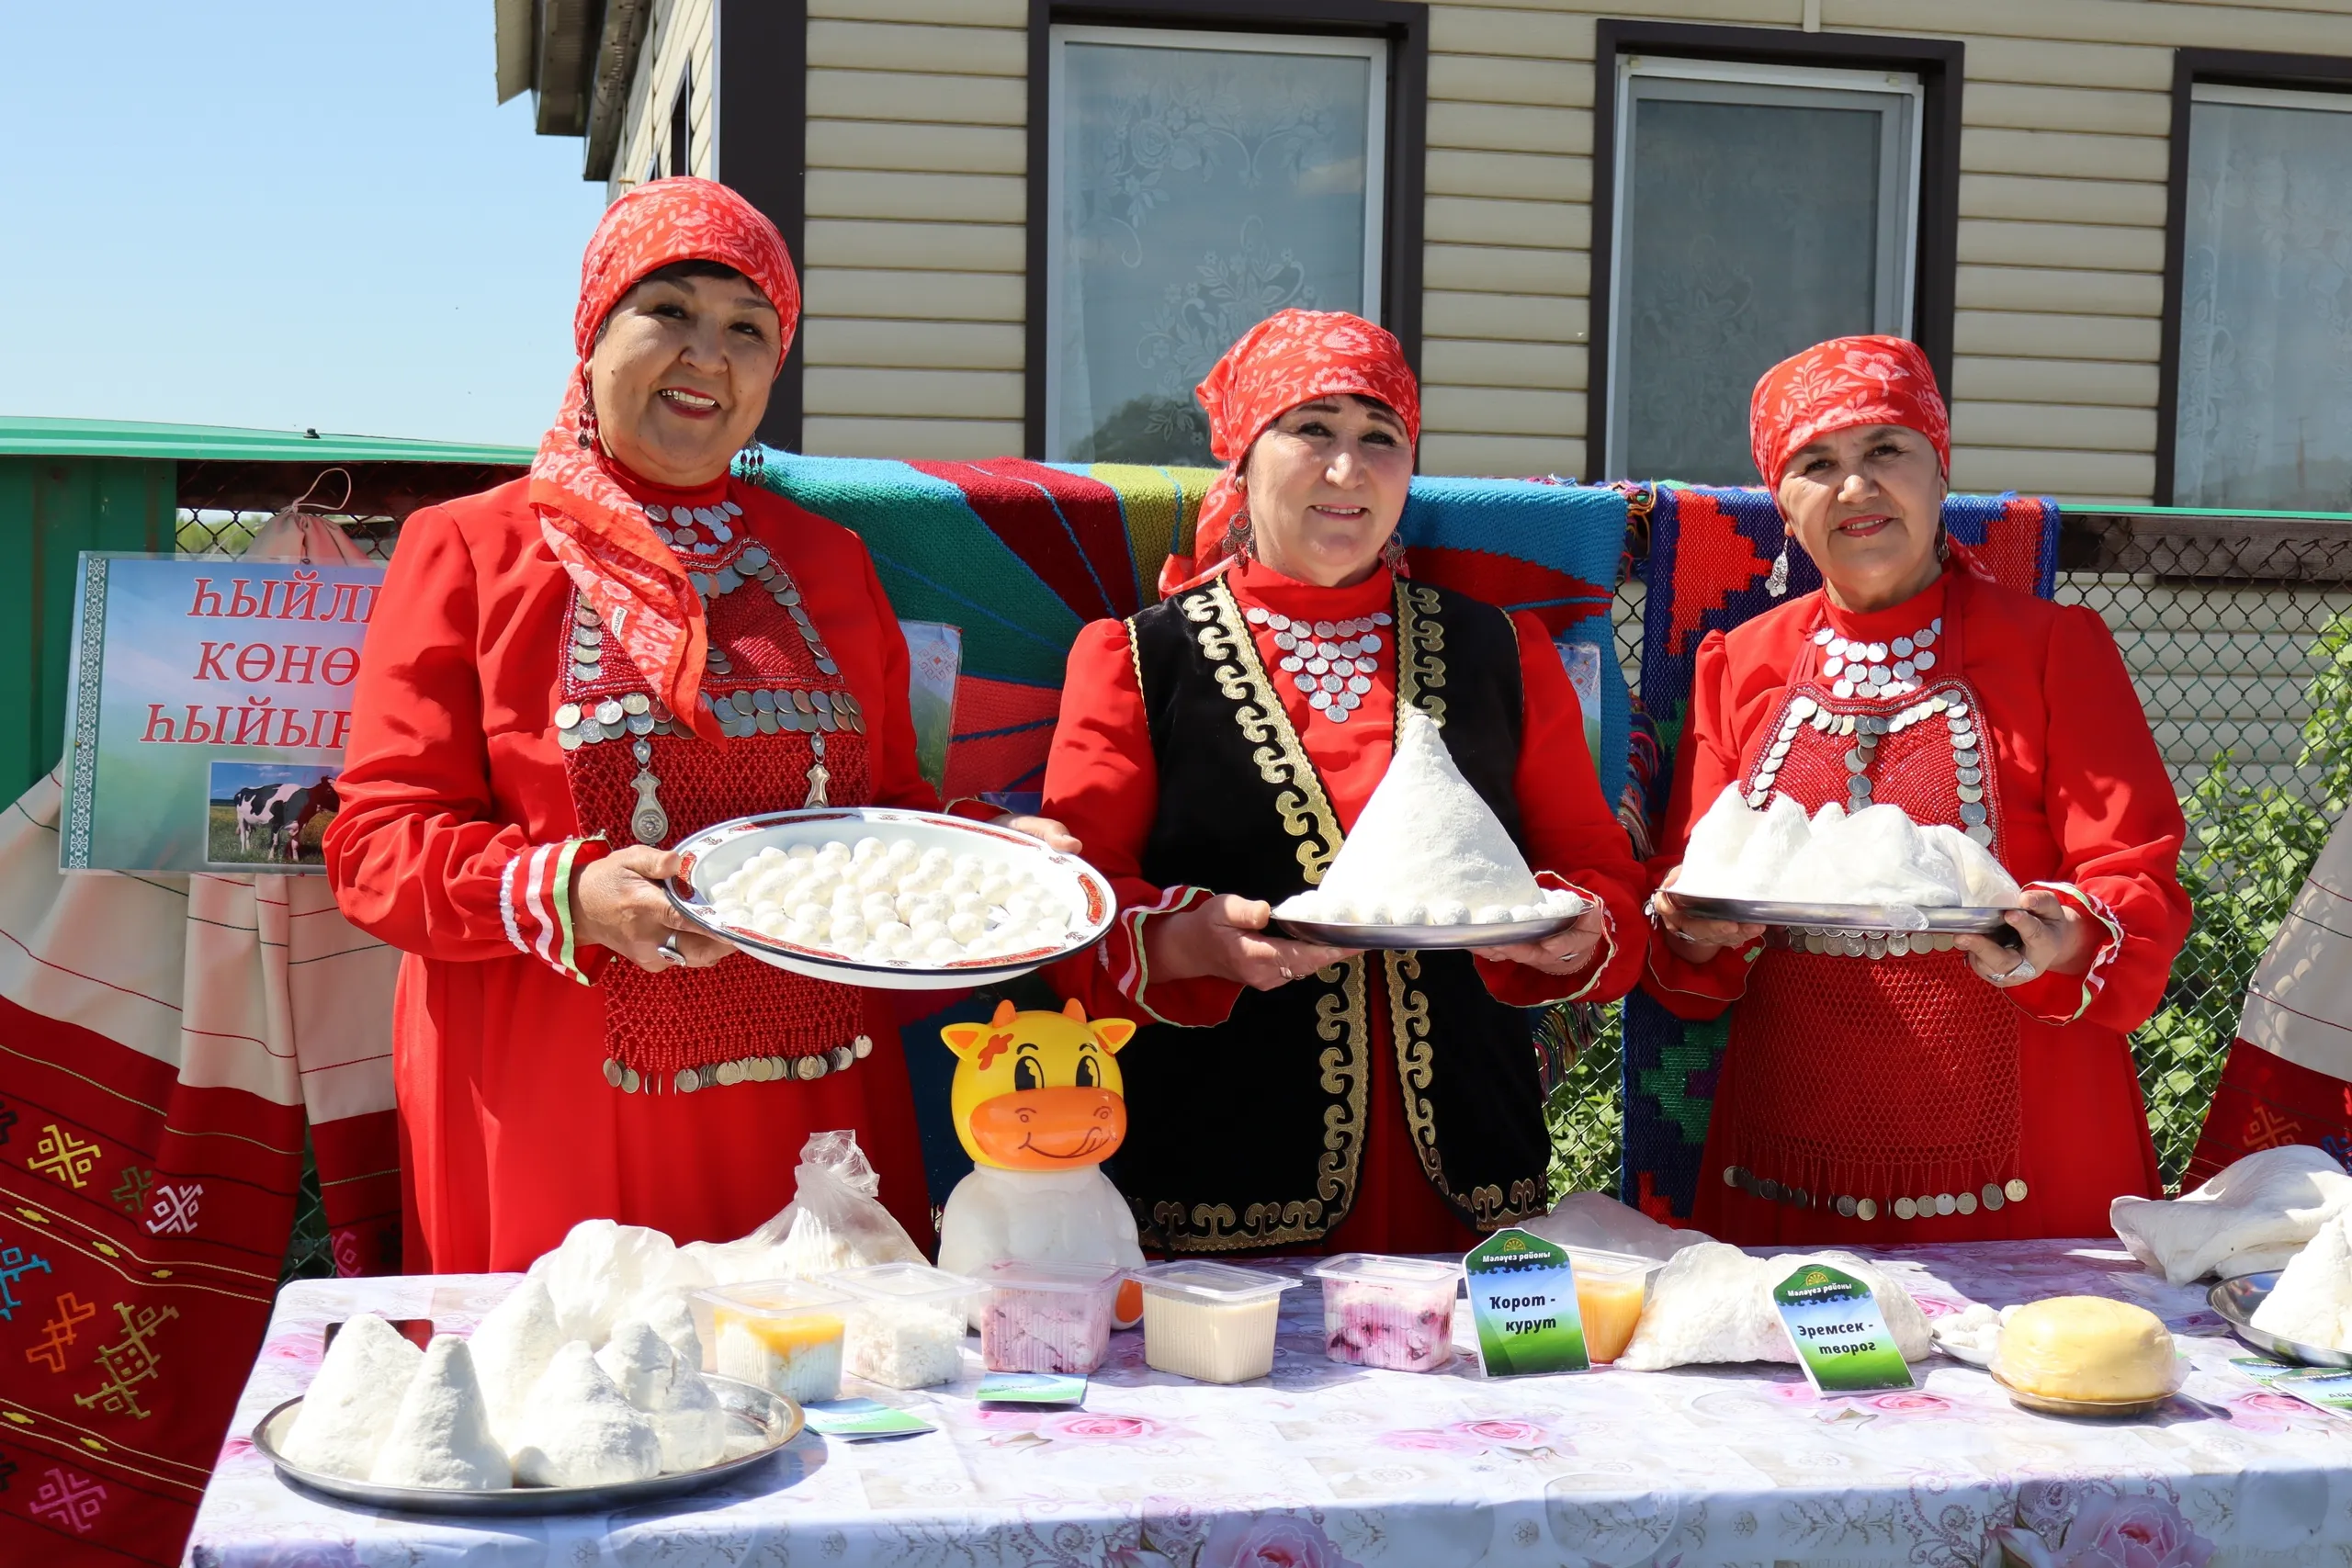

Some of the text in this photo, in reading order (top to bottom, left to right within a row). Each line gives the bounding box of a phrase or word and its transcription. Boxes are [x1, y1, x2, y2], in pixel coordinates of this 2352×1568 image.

[193, 641, 361, 687] КӨНӨ
[1519, 1251, 1551, 1262] районы
[1824, 1282, 1852, 1293] районы
[1505, 1317, 1556, 1335] курут
[1797, 1322, 1864, 1340] Эремсек
[1818, 1341, 1876, 1356] творог
